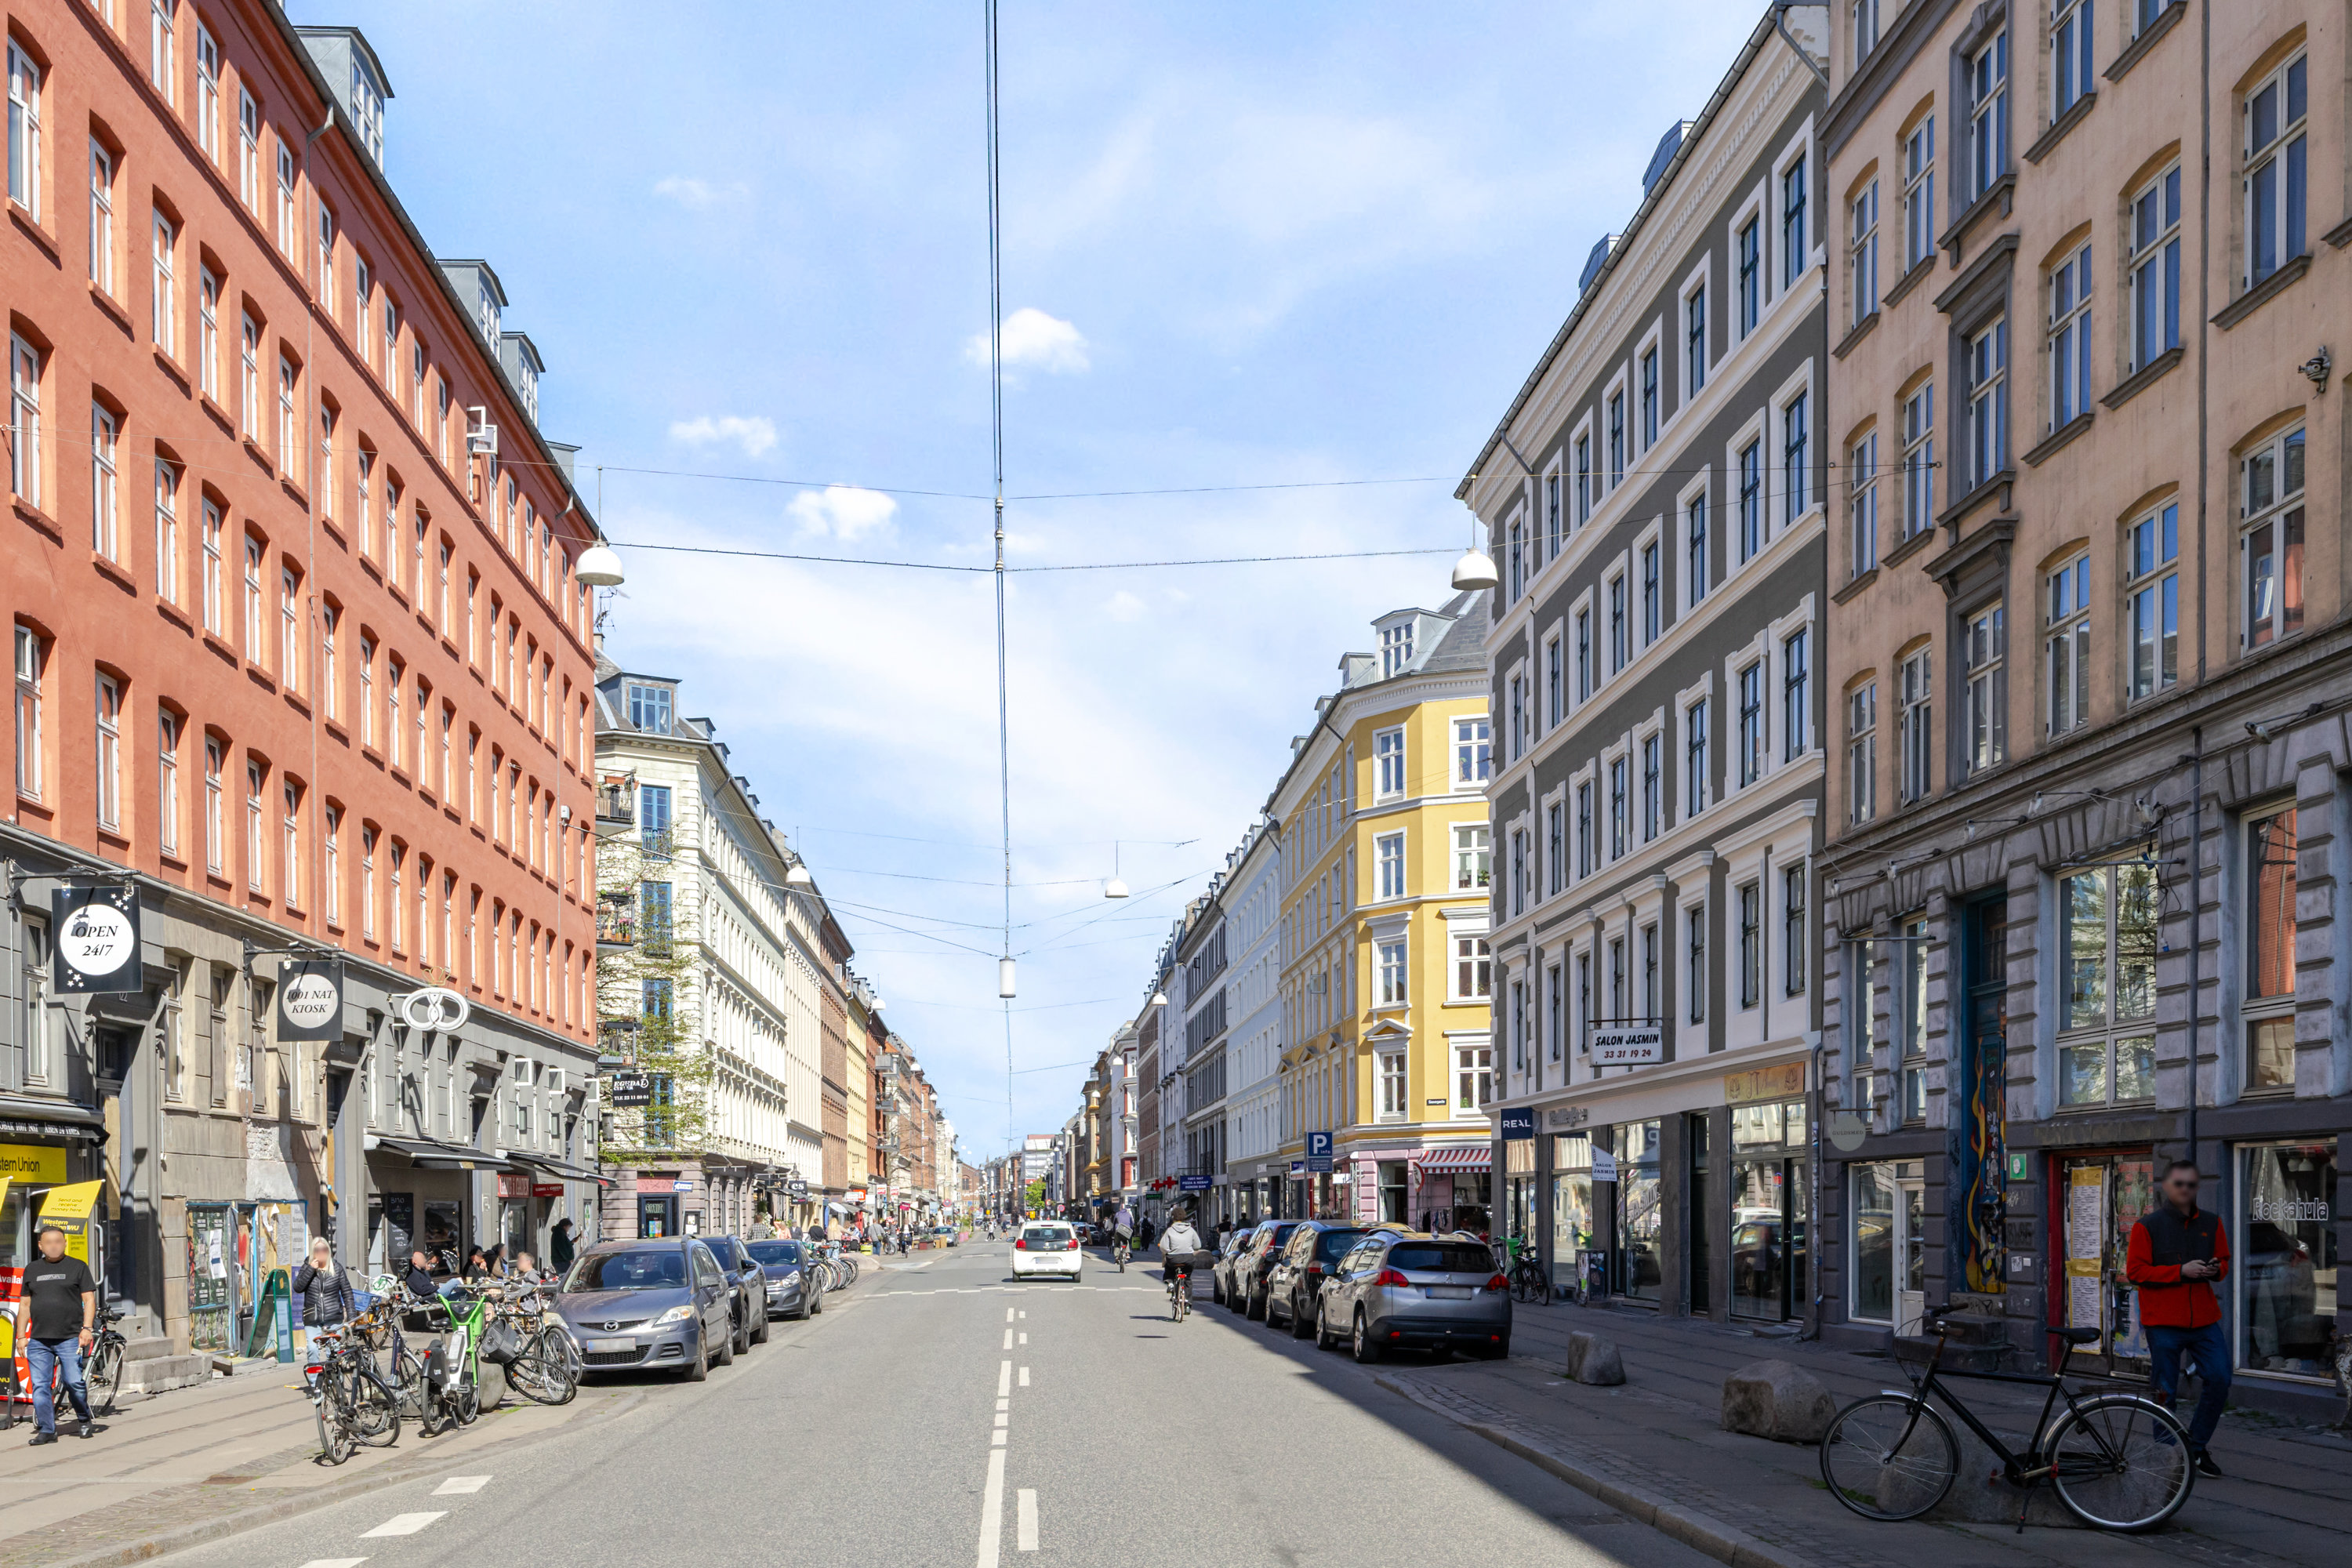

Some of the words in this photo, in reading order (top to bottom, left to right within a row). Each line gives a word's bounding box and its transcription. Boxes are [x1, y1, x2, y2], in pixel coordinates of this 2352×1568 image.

[75, 925, 118, 938] OPEN
[82, 944, 114, 956] 24/7
[286, 990, 309, 1000] 1001
[311, 990, 335, 999] NAT
[292, 1004, 328, 1014] KIOSK
[1595, 1036, 1624, 1047] SALON
[1626, 1033, 1659, 1045] JASMIN
[1617, 1050, 1626, 1058] 31
[1631, 1049, 1639, 1058] 19
[614, 1079, 648, 1087] EGEDAL
[1502, 1120, 1531, 1128] REAL
[1312, 1134, 1327, 1154] P
[18, 1156, 40, 1172] Union
[2252, 1197, 2328, 1221] Rockahula
